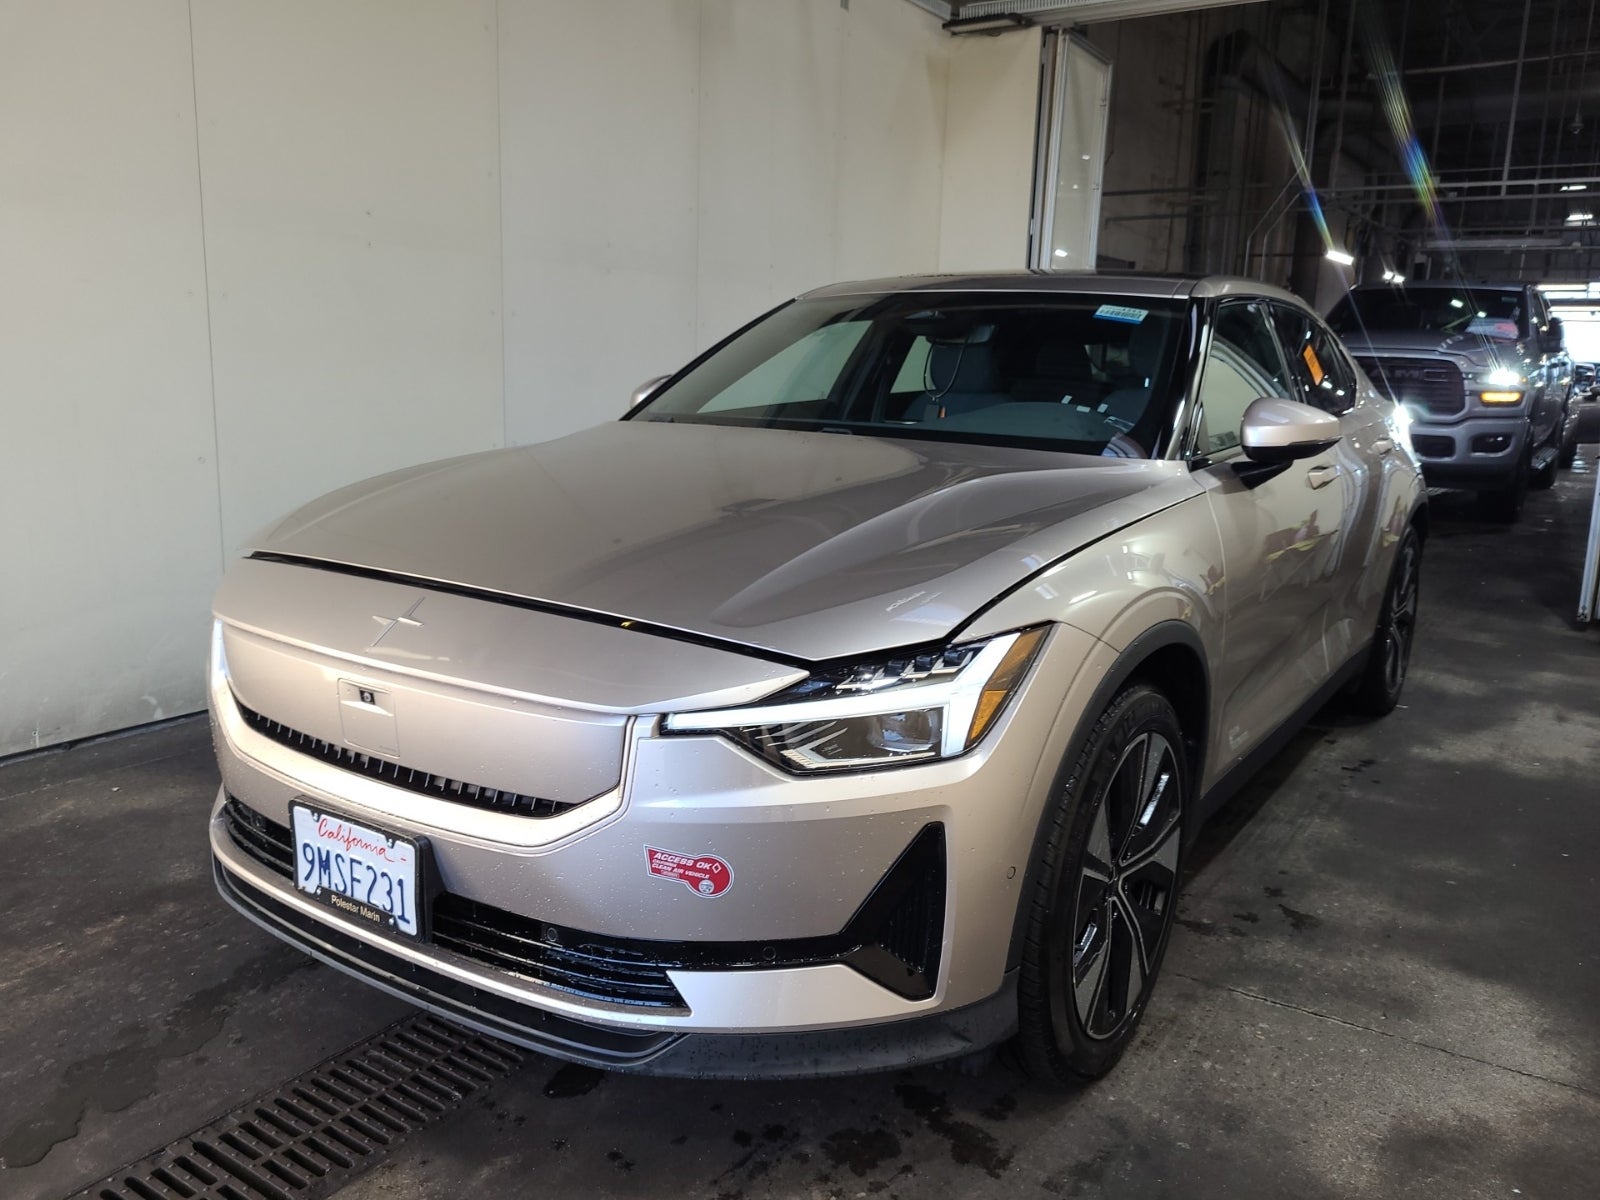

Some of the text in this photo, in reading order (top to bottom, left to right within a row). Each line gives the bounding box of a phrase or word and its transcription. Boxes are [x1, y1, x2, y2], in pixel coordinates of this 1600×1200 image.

[318, 817, 395, 863] California
[652, 863, 672, 872] CLEAN
[685, 870, 710, 879] VEHICLE
[653, 852, 712, 870] ACCESS OK
[302, 842, 411, 925] 9MSF231
[331, 895, 381, 923] Polestar Marin
